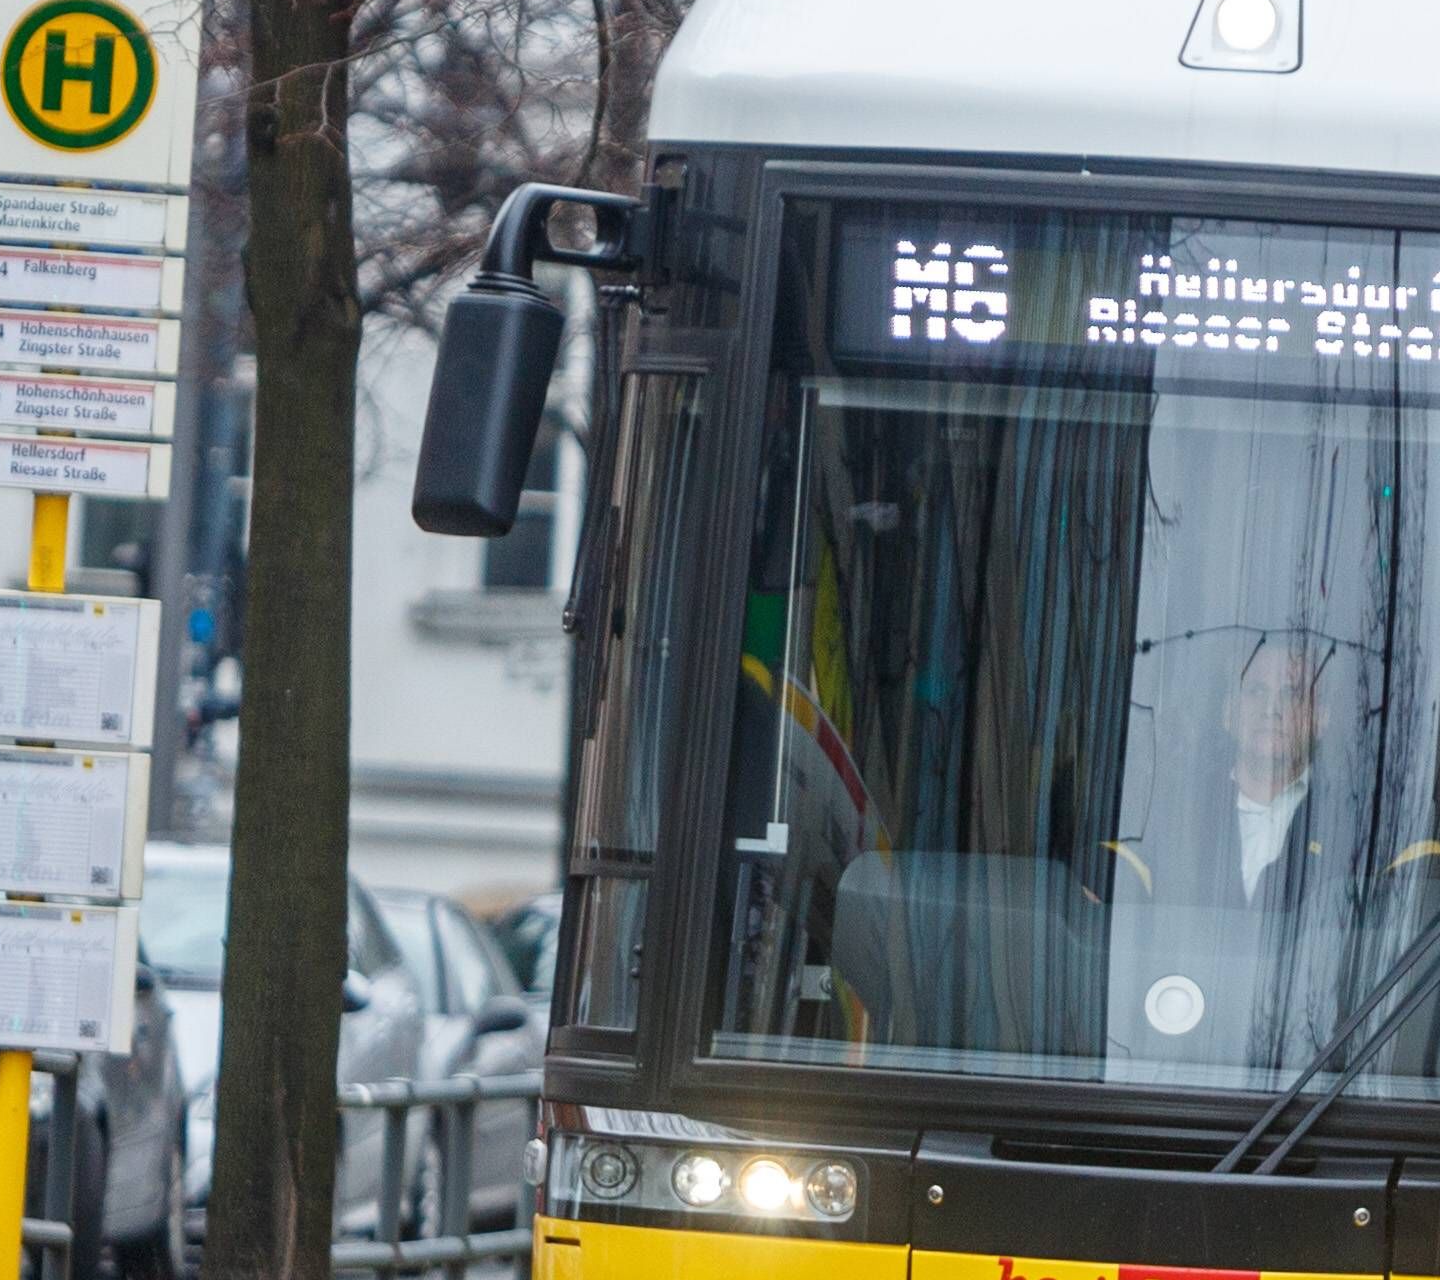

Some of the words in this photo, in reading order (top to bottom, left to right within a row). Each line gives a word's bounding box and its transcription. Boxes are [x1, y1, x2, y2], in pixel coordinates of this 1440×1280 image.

[41, 29, 116, 115] H
[23, 259, 98, 281] Falkenberg
[19, 321, 149, 344] Hohenschönhausen
[18, 339, 73, 357] Zingster
[77, 343, 121, 360] Straße
[15, 384, 146, 406] Hohenschönhausen
[14, 401, 69, 419] Zingster
[73, 405, 117, 422] Straße
[11, 444, 87, 462] Hellersdorf
[10, 462, 59, 478] Riesaer
[63, 465, 107, 482] Straße
